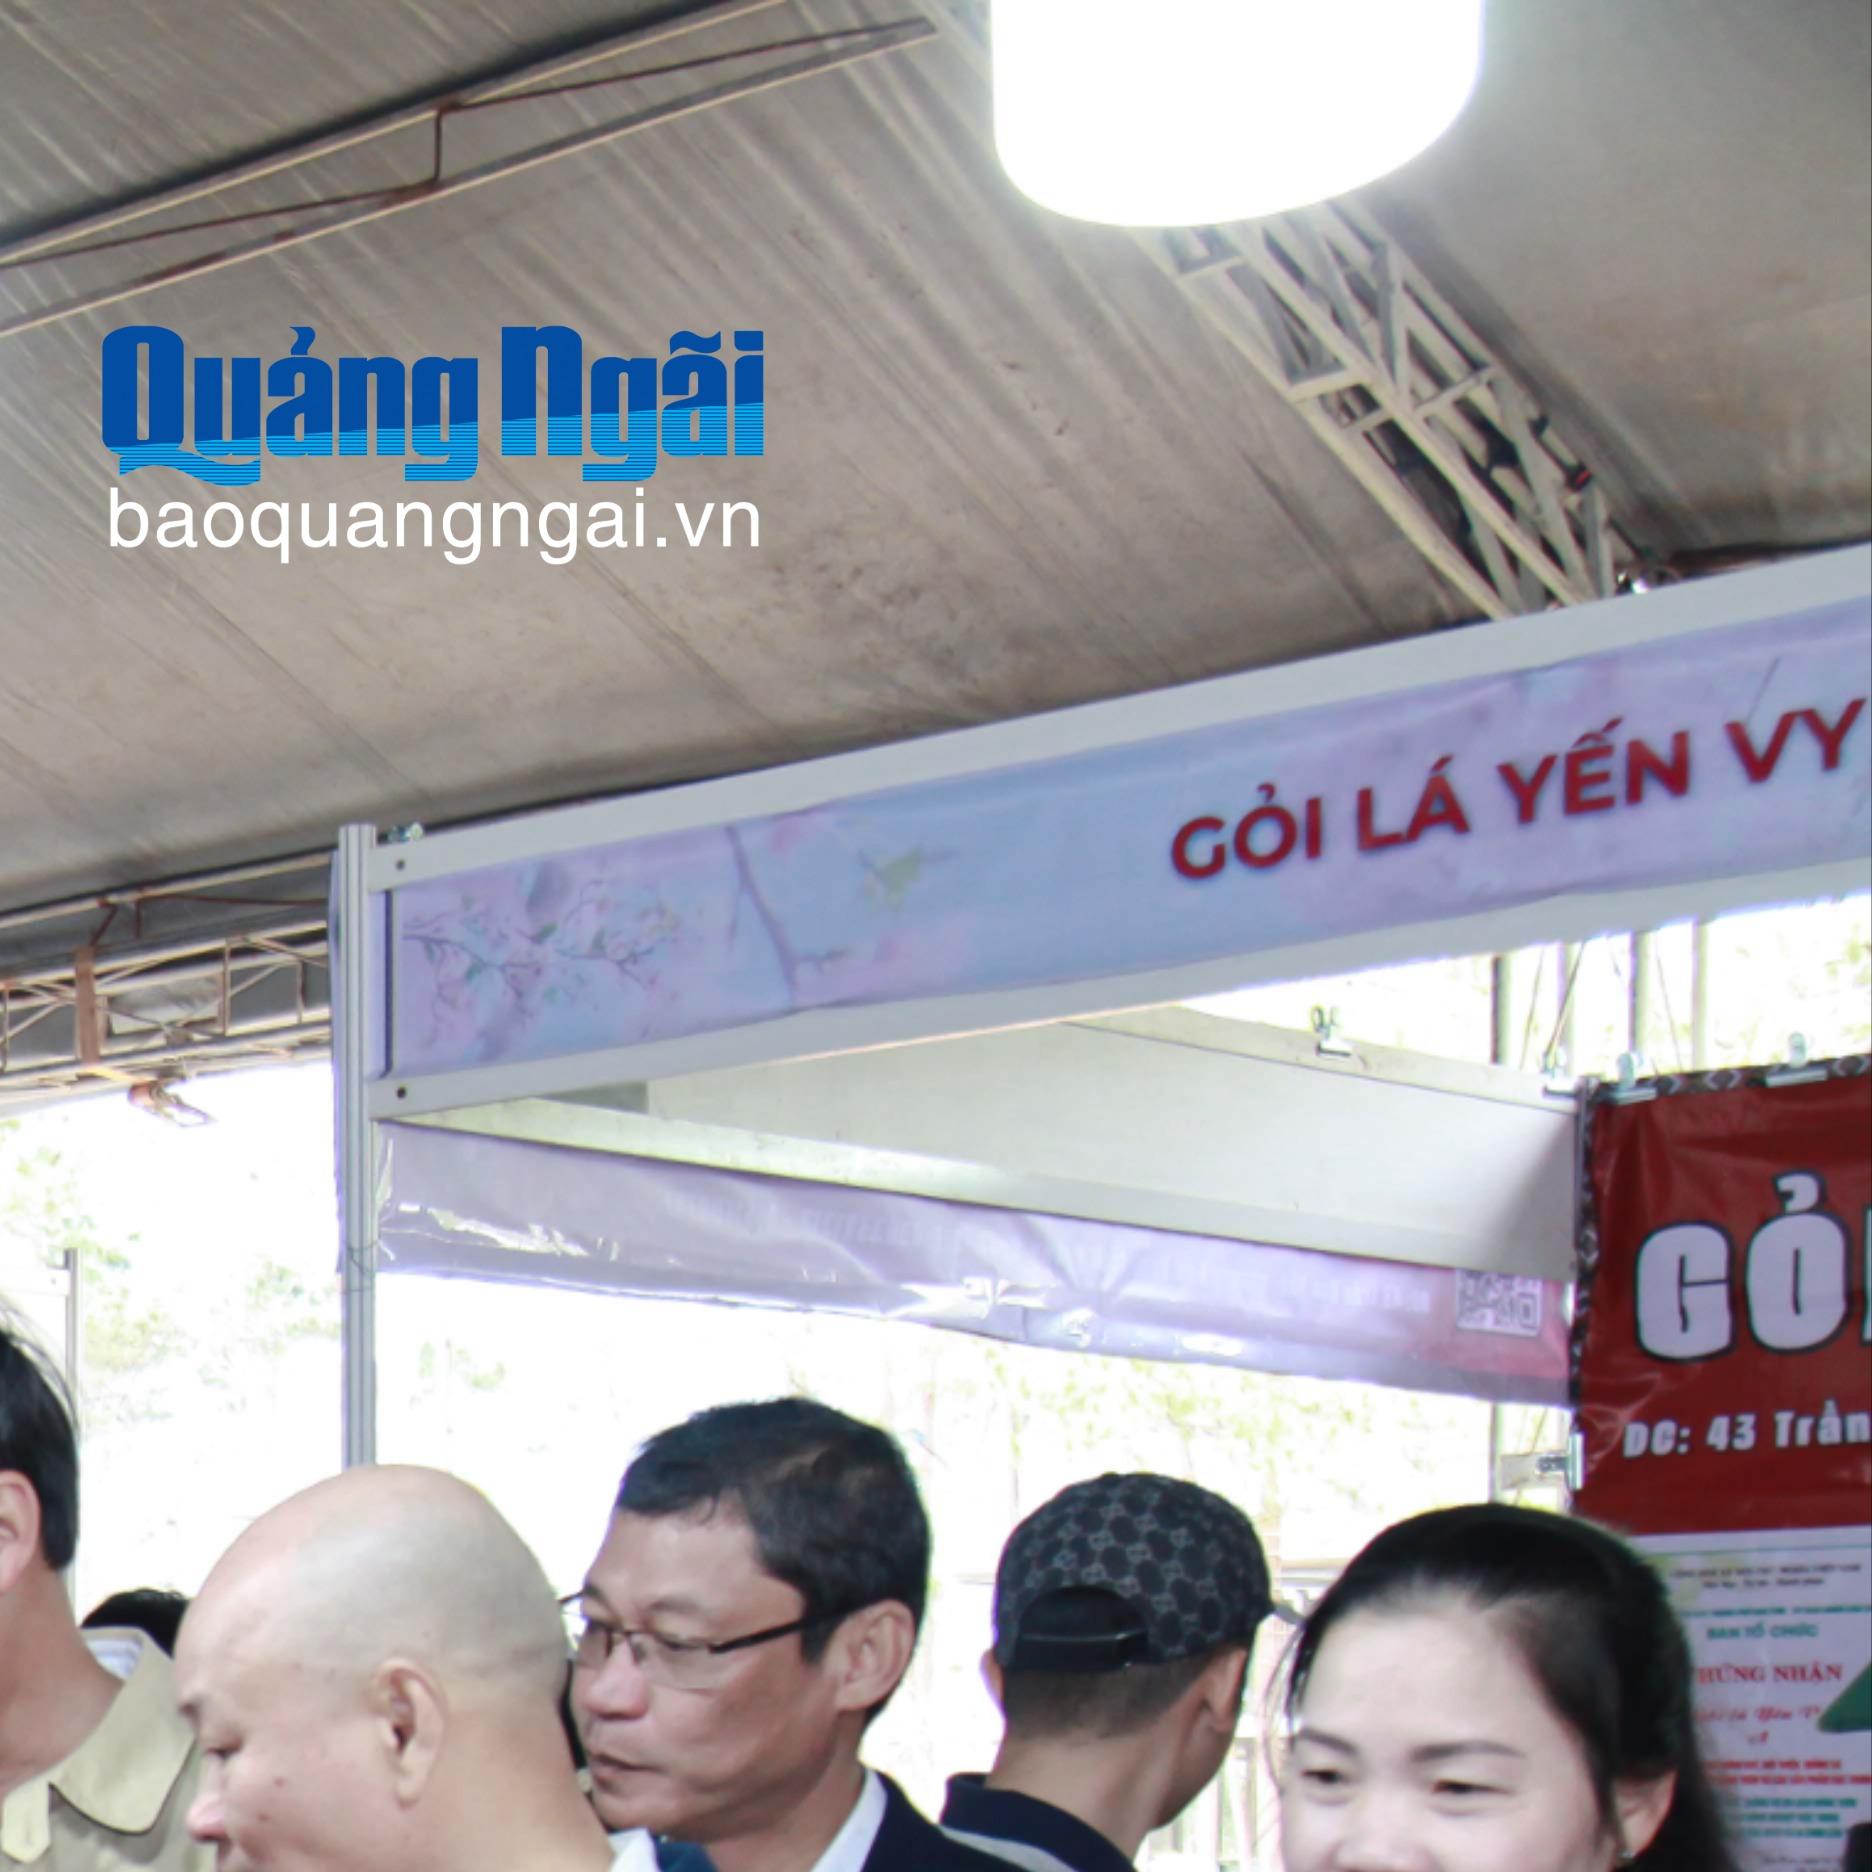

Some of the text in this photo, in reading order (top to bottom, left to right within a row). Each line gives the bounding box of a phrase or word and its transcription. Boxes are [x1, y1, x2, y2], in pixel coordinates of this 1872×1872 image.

[1171, 698, 1867, 879] GỎI LÁ YẾN VY
[1634, 1170, 1872, 1362] GỎ
[1706, 1411, 1757, 1452] 43
[1773, 1398, 1872, 1449] Trần
